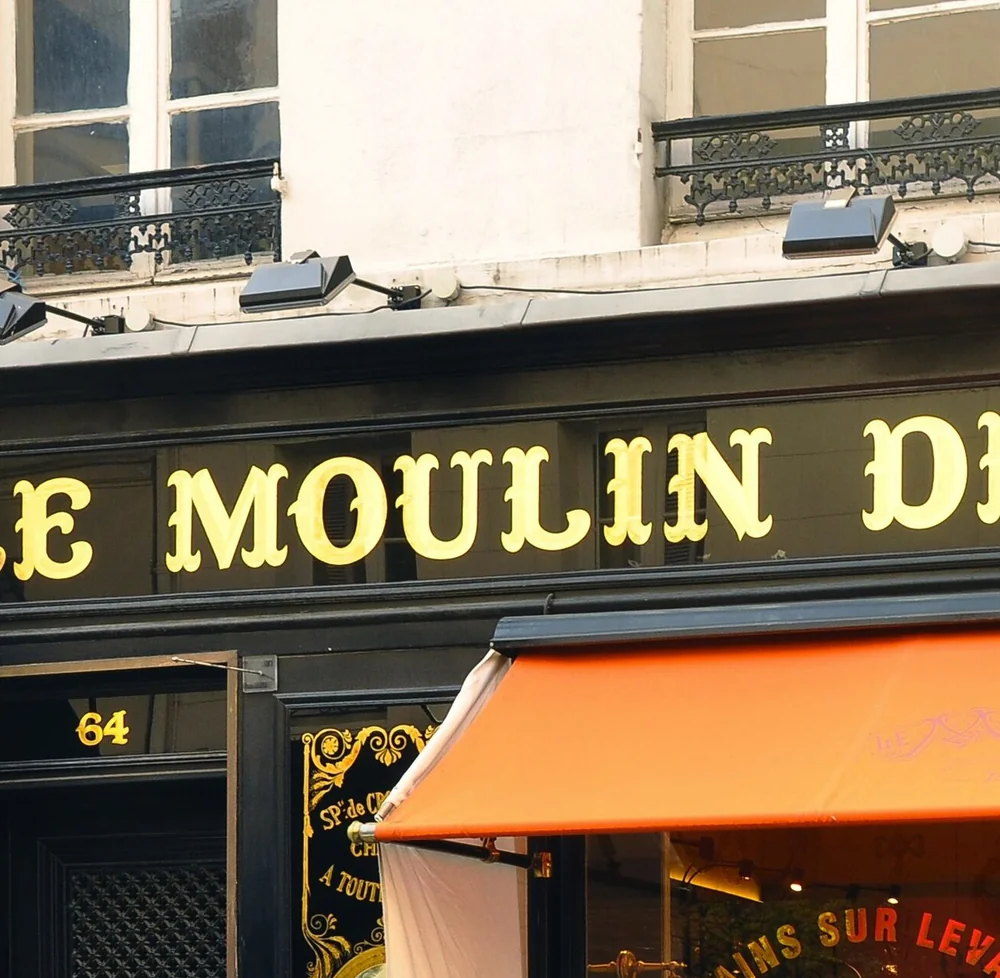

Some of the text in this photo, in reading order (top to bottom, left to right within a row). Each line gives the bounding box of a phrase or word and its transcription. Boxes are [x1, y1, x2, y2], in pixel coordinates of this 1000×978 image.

[0, 477, 93, 580] E
[166, 427, 774, 574] MOULIN
[75, 709, 130, 747] 64
[319, 864, 335, 887] A
[818, 907, 898, 948] SUR
